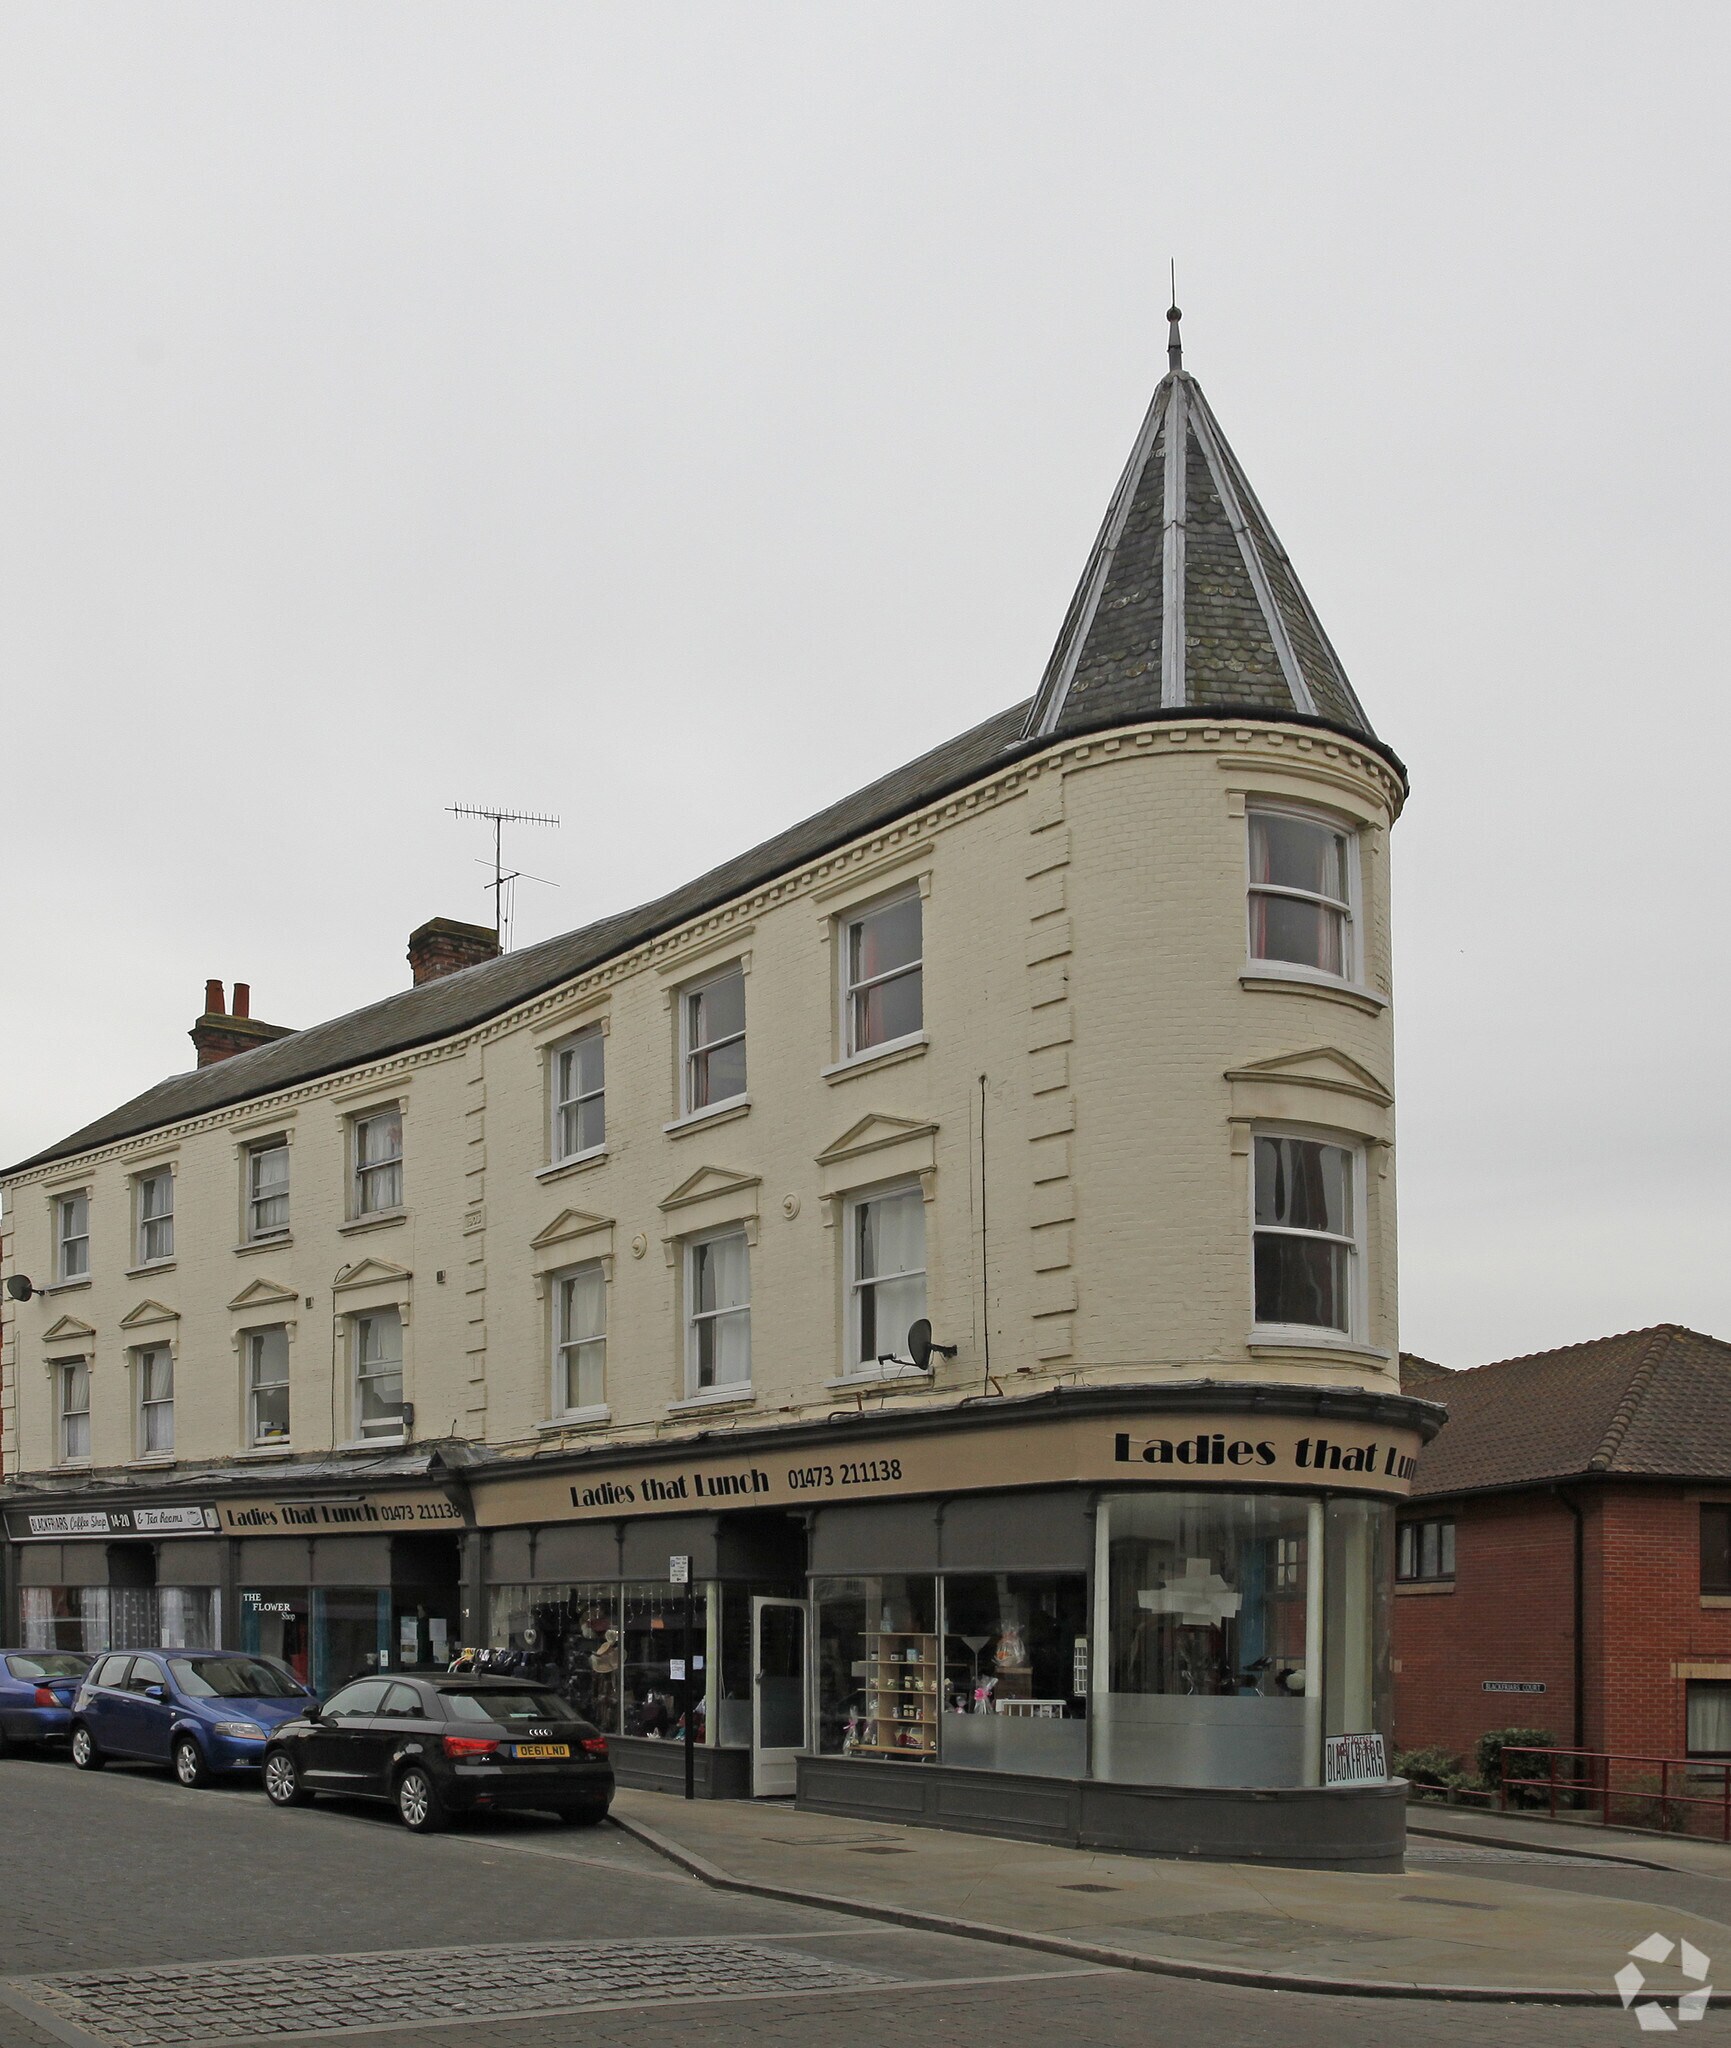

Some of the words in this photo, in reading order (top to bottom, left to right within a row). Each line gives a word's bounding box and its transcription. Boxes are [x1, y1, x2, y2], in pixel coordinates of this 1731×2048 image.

[1114, 1433, 1276, 1466] Ladies
[1294, 1437, 1379, 1473] that
[787, 1465, 834, 1489] 01473
[839, 1459, 902, 1485] 211138
[569, 1481, 635, 1508] Ladies
[640, 1475, 689, 1501] that
[693, 1468, 769, 1497] Lunch
[144, 1511, 158, 1525] Tea
[159, 1511, 184, 1524] Rooms
[226, 1508, 278, 1527] Ladies
[281, 1507, 318, 1524] that
[320, 1502, 379, 1523] Lunch
[381, 1504, 415, 1521] 01473
[417, 1502, 462, 1520] 211138
[31, 1516, 69, 1533] BLACKFRIARS
[69, 1518, 89, 1531] Coffee
[90, 1515, 107, 1529] Shop
[110, 1513, 130, 1527] 14-20
[243, 1593, 261, 1601] THE
[253, 1602, 291, 1611] FLOWER
[281, 1611, 296, 1622] Shop
[1485, 1683, 1520, 1691] BLACKFRIARS
[1522, 1684, 1541, 1692] COURT
[520, 1746, 544, 1756] OE61
[546, 1746, 566, 1755] LND
[1327, 1740, 1385, 1782] BLACKFRIARS
